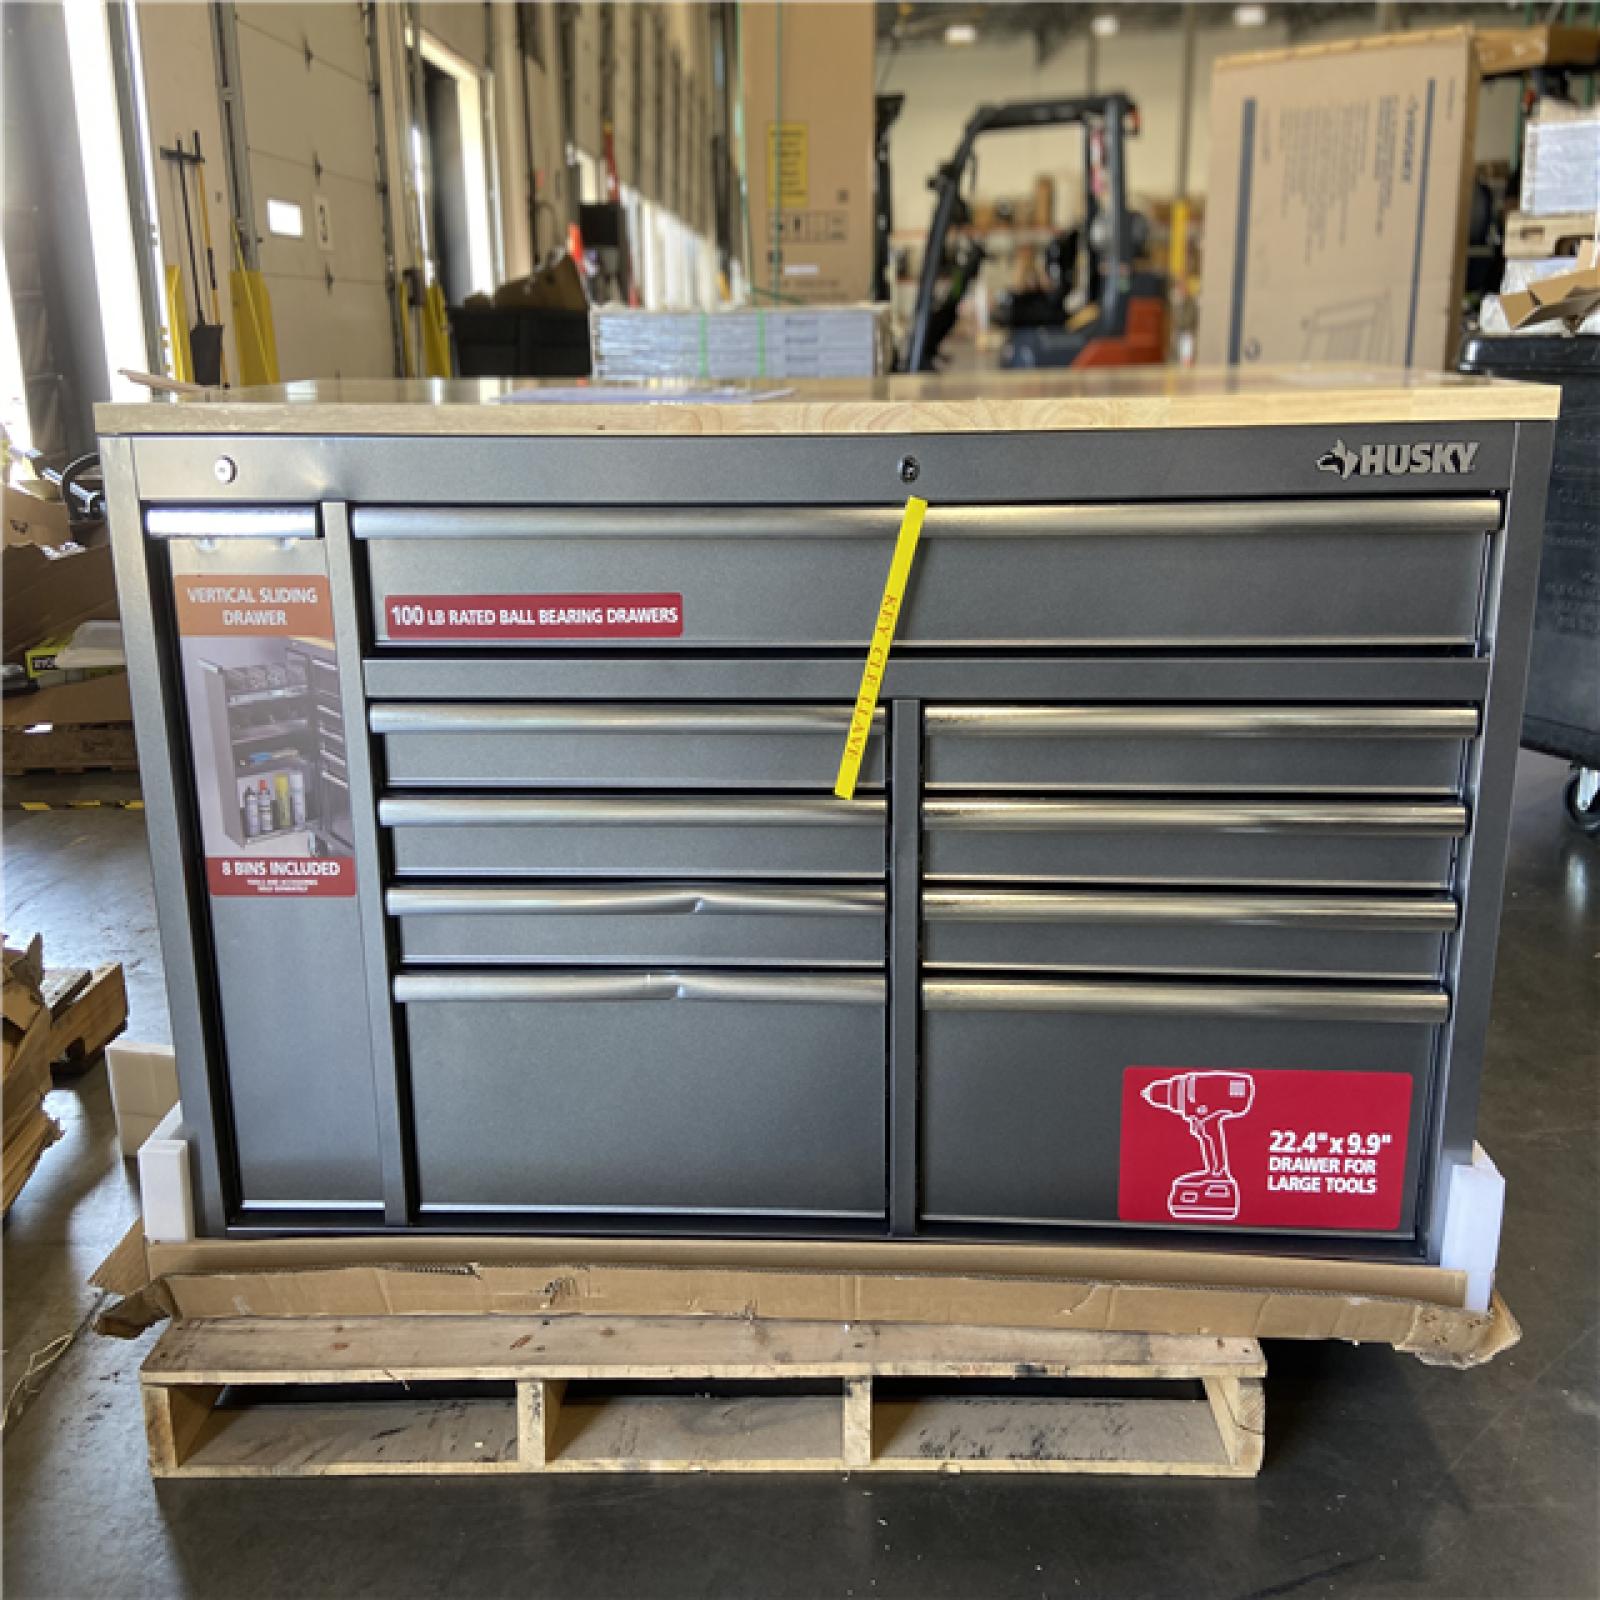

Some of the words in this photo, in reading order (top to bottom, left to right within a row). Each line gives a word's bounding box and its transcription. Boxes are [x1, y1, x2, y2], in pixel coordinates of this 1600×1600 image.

[1360, 441, 1479, 475] HUSKY
[187, 587, 255, 603] VERTICAL
[259, 586, 318, 603] SLIDING
[222, 610, 288, 626] DRAWER
[391, 605, 424, 625] 100
[427, 609, 446, 625] LB
[449, 609, 496, 625] RATED
[499, 609, 536, 625] BALL
[539, 607, 603, 624] BEARING
[607, 606, 679, 624] DRAWERS
[221, 860, 232, 876] 8
[234, 860, 267, 876] BINS
[269, 860, 341, 876] INCLUDED
[1269, 1129, 1328, 1153] 22.4"
[1346, 1131, 1393, 1155] 9.9"
[1268, 1156, 1341, 1173] DRAWER
[1343, 1158, 1377, 1174] FOR
[1267, 1174, 1321, 1192] LARGE
[1324, 1176, 1377, 1194] TOOLS
